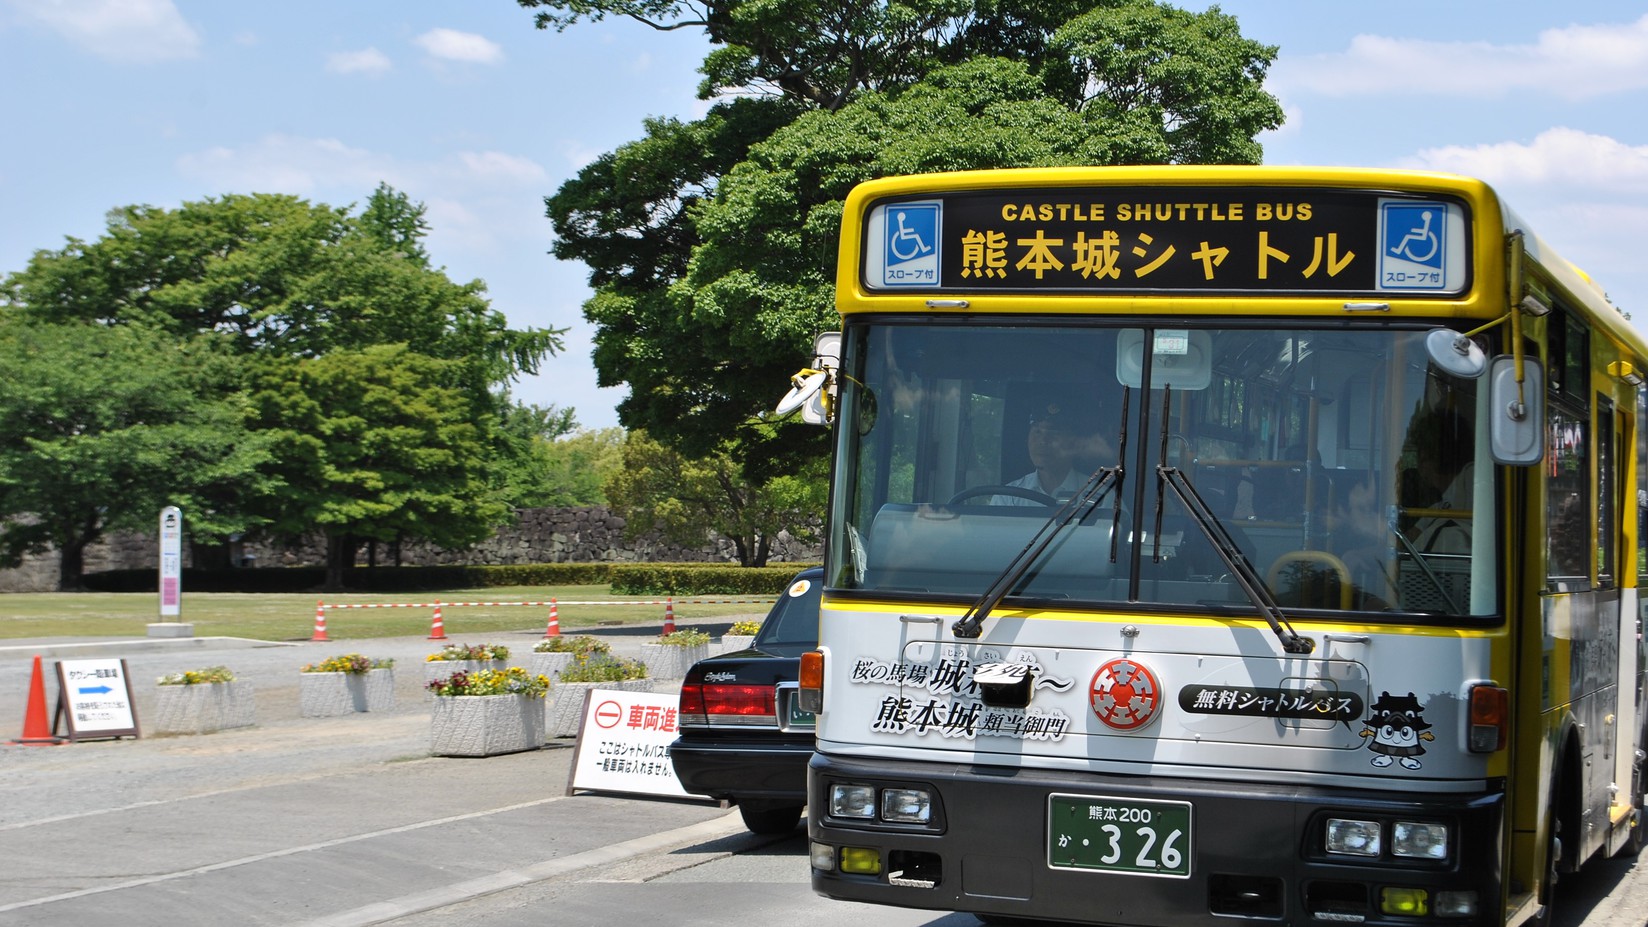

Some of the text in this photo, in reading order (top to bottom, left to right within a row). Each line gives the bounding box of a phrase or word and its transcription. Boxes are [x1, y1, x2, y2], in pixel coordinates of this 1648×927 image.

[1001, 202, 1313, 222] CASTLE SHUTTLE BUS
[960, 228, 1356, 280] 熊本城シャトル
[887, 268, 935, 280] スロープ付
[1385, 271, 1441, 283] スロープ付
[1192, 688, 1353, 714] 無料シャトルバス
[626, 704, 680, 733] 車両進
[1088, 805, 1152, 824] 熊本200
[1058, 833, 1072, 848] か
